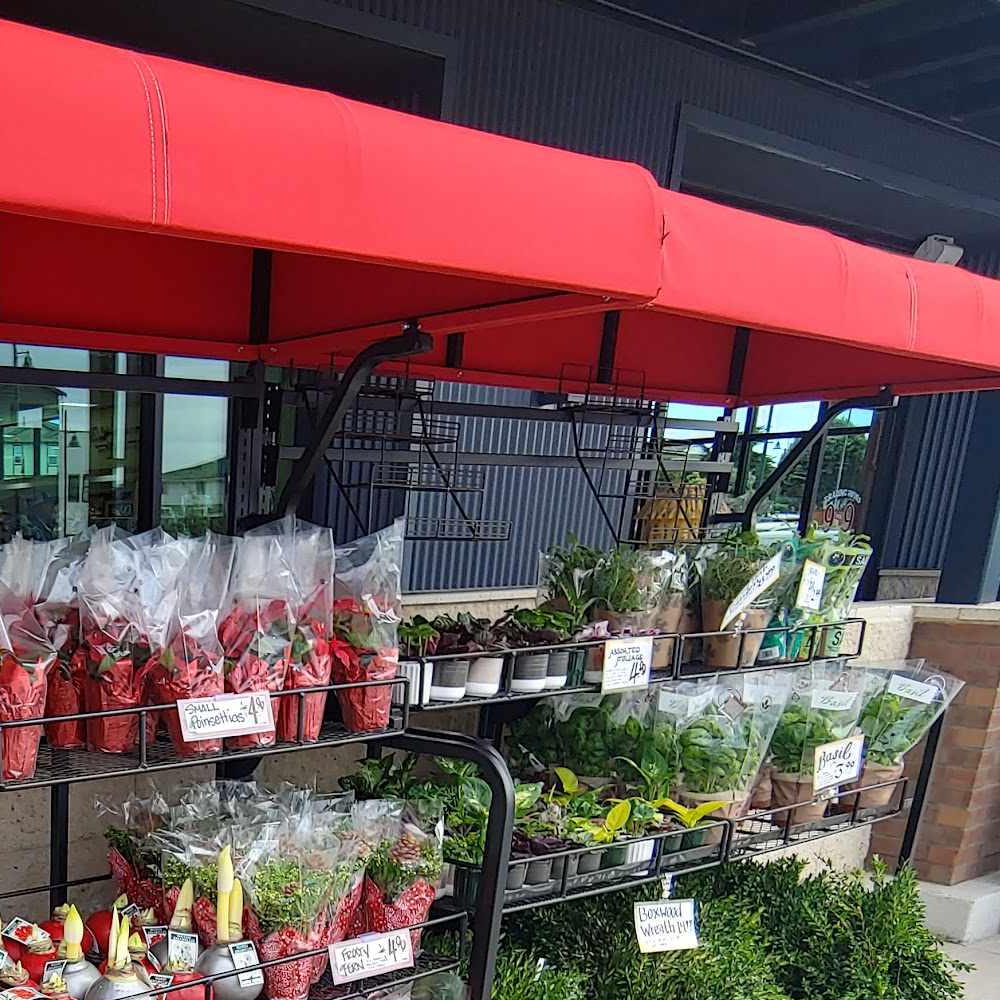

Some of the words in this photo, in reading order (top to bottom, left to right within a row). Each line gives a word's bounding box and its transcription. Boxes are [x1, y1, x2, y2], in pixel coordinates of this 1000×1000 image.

[185, 703, 219, 715] SMALL
[817, 742, 852, 773] Basil
[640, 920, 676, 937] Wreath
[341, 959, 365, 976] FERN
